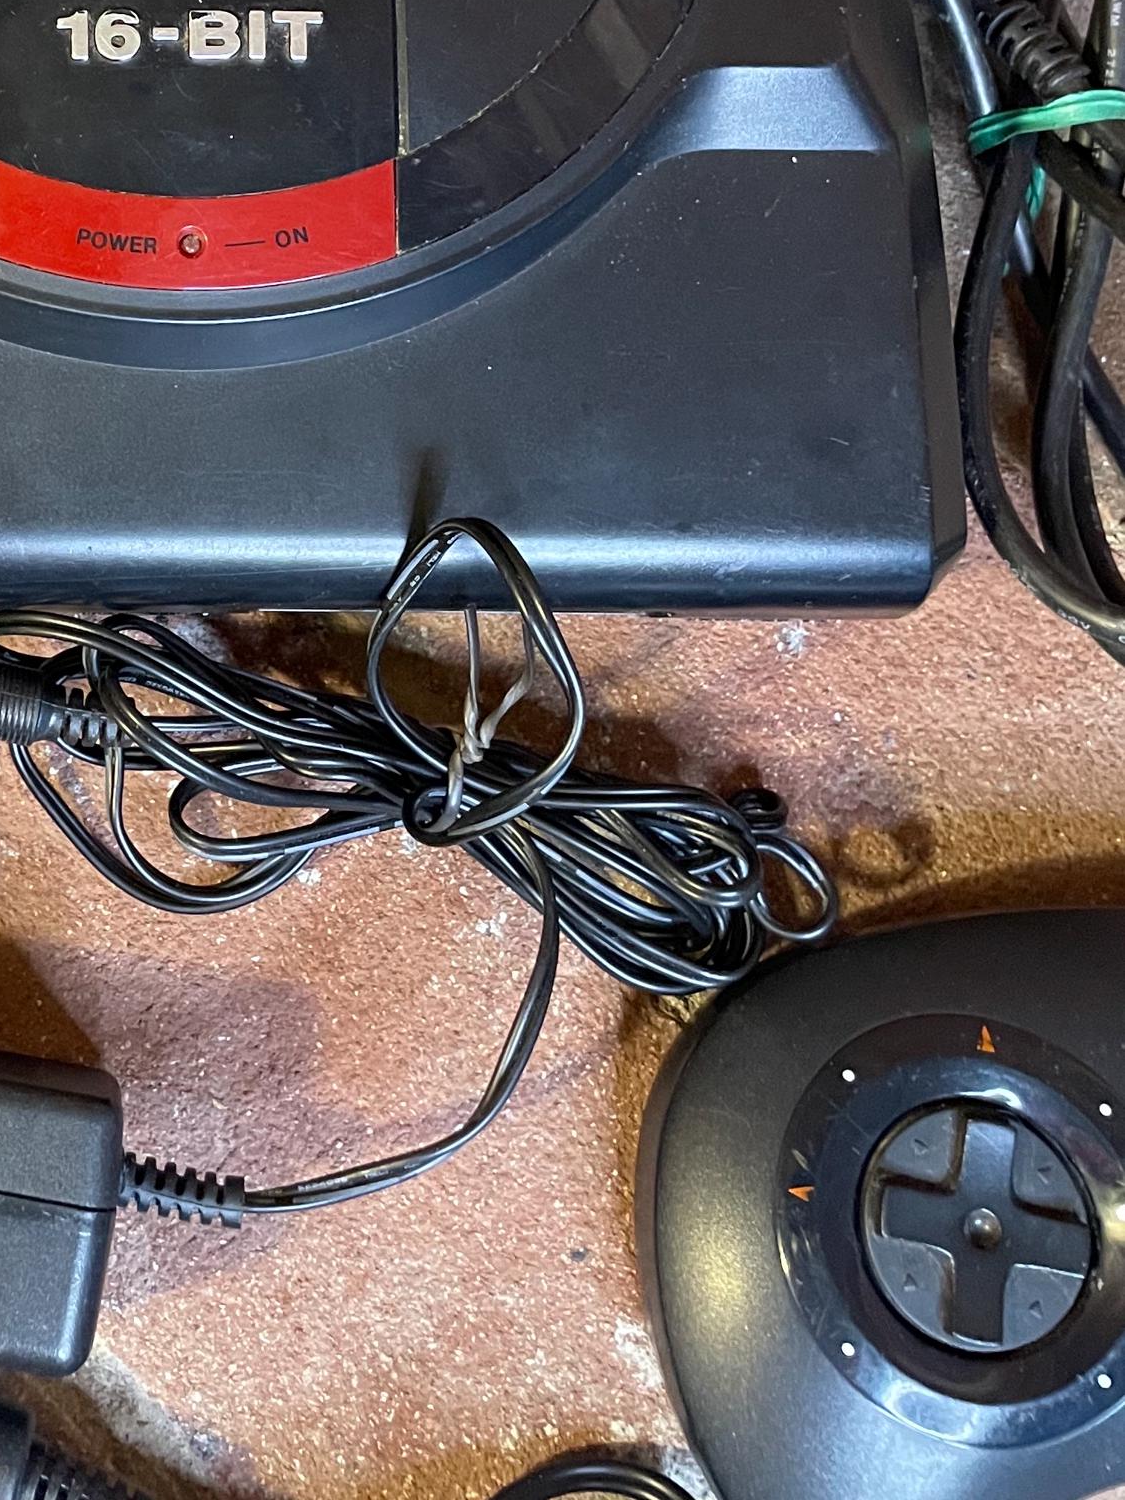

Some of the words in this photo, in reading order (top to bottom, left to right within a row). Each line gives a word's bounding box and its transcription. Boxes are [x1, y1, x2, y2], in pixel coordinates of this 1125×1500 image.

[56, 9, 324, 63] 16-BIT
[77, 228, 157, 255] POWER
[275, 227, 310, 248] ON
